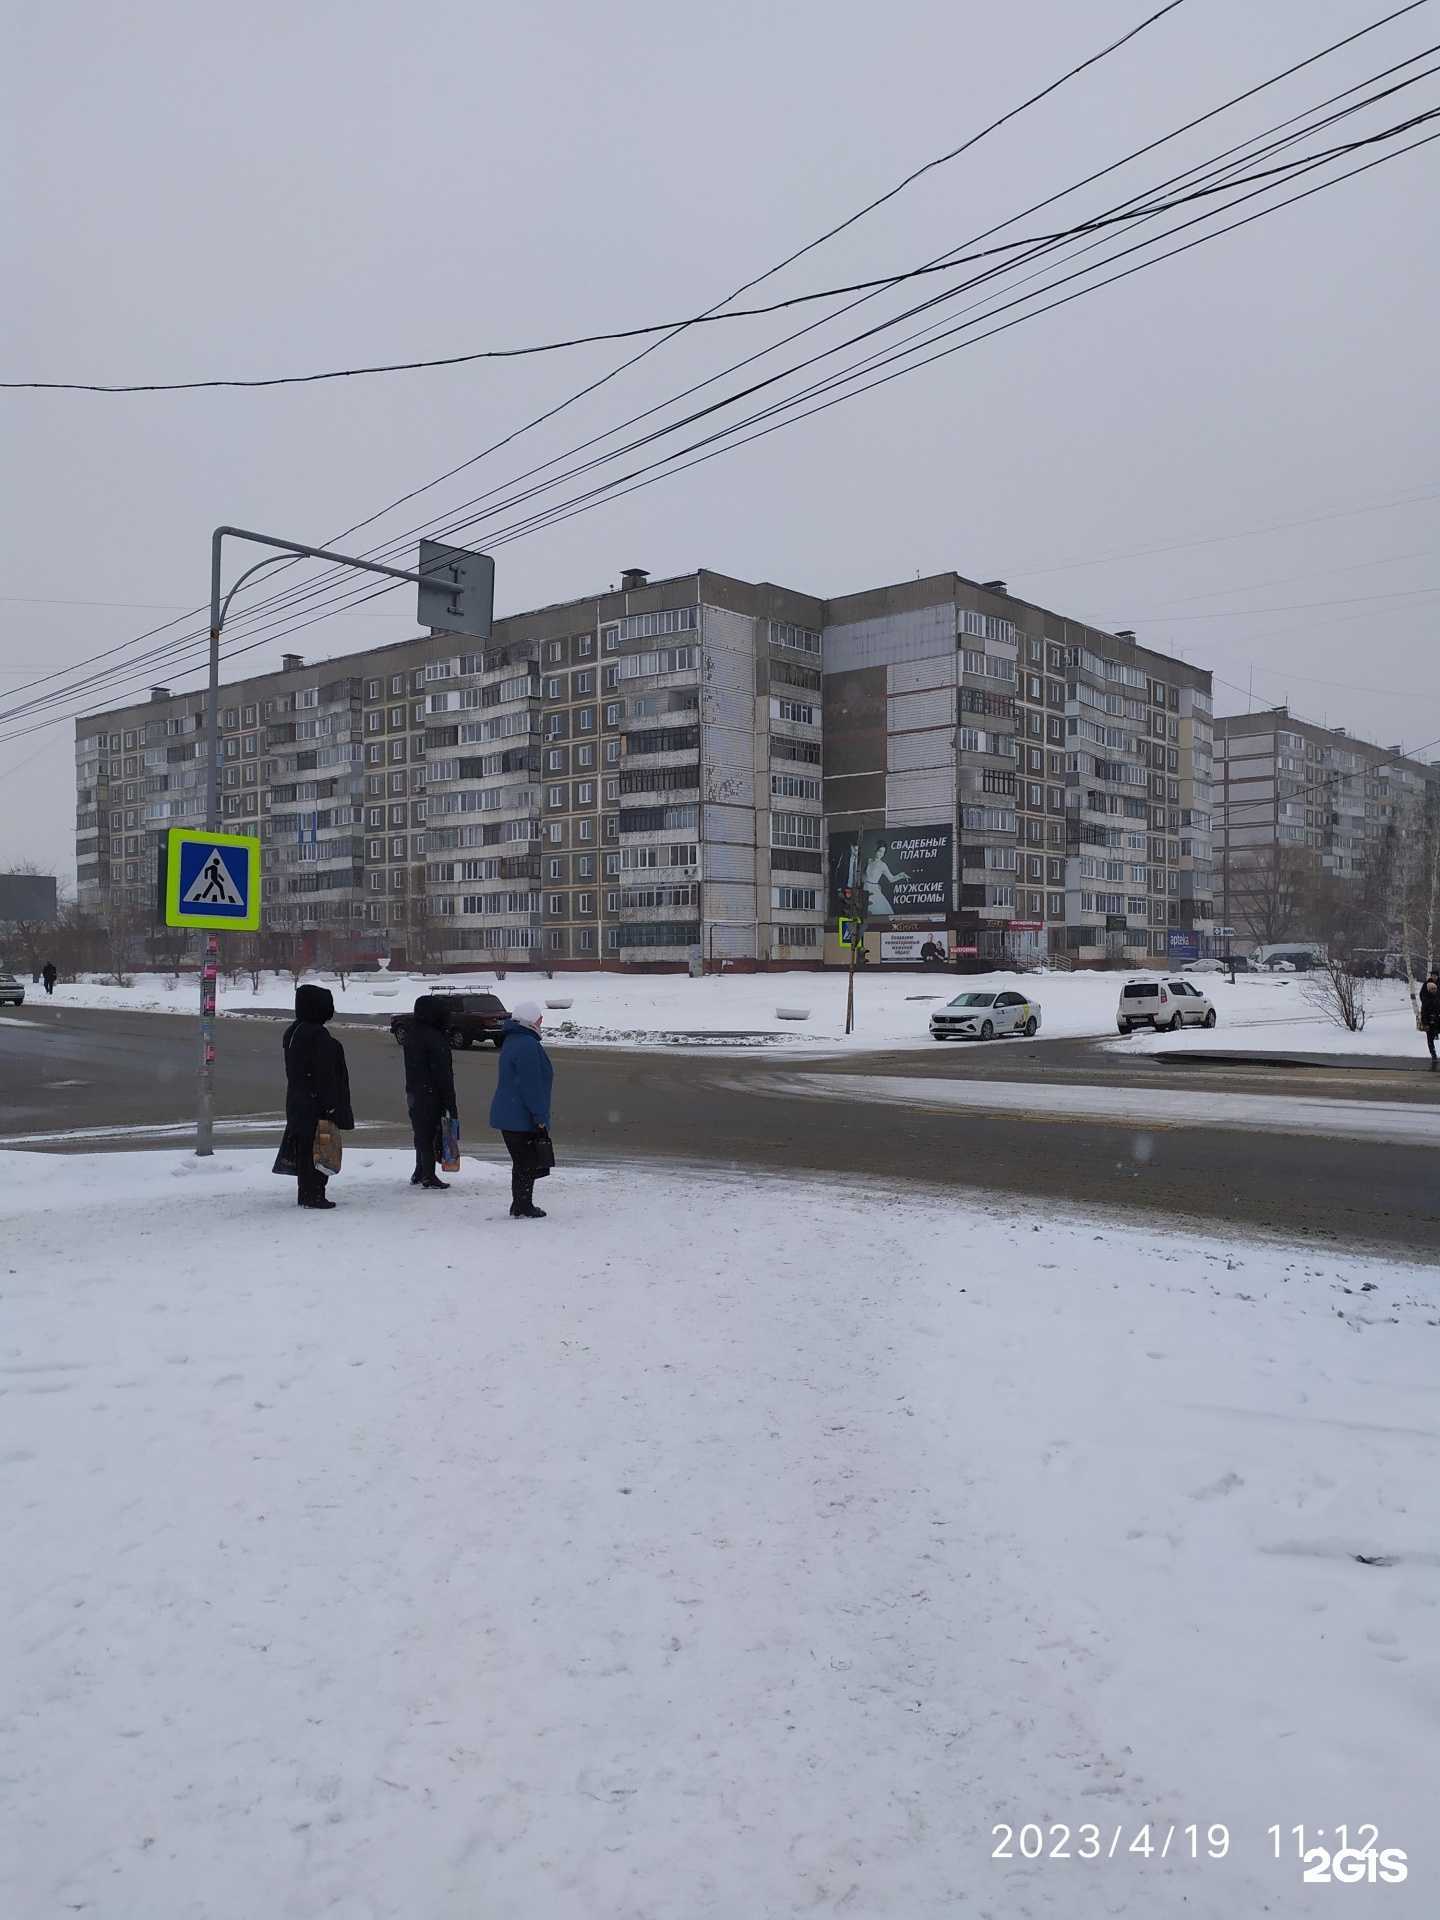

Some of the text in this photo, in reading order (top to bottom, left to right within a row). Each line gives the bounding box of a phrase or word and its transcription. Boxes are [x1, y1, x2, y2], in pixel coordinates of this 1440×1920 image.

[890, 836, 948, 850] СВАДЕБНЫЕ
[900, 848, 938, 860] ПЛАТЬЯ
[893, 881, 944, 894] МУЖСКИЕ
[893, 893, 945, 905] КОСТЮМЫ
